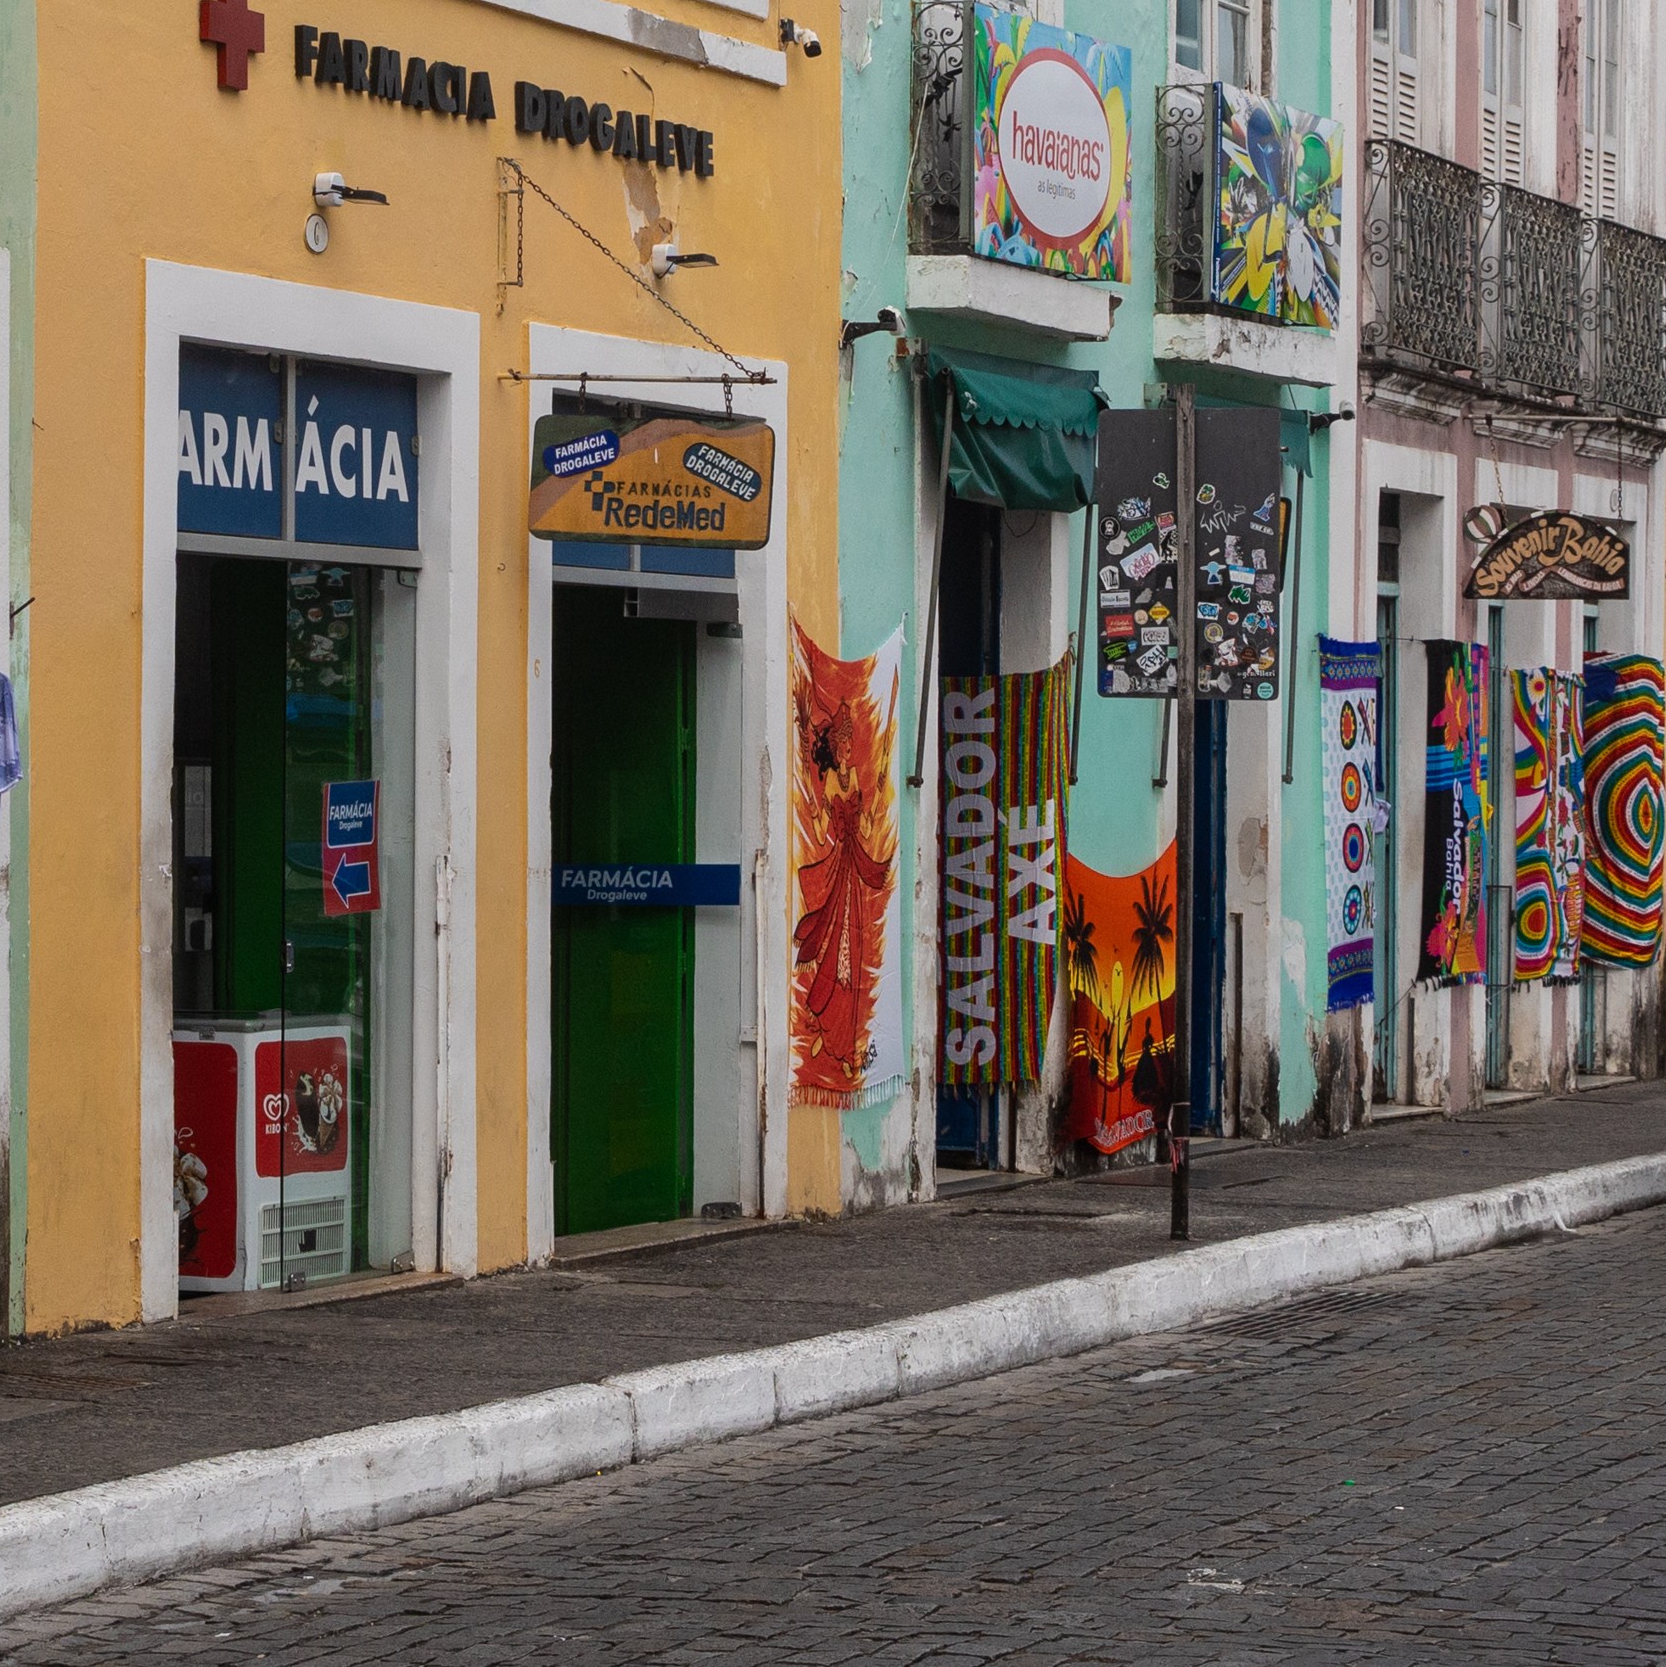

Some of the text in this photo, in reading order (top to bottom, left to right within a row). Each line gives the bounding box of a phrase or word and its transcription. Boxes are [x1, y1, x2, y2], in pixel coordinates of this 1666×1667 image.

[294, 24, 715, 177] FARMACIA DROGALEVE
[1012, 109, 1101, 183] havaianas
[1037, 180, 1046, 194] as
[295, 394, 409, 503] ÁCIA
[553, 447, 615, 476] DROGALEVE
[555, 434, 607, 459] FARMÁCIA
[697, 445, 755, 483] FARMÁCIA
[685, 454, 756, 502] DROGALEVE
[604, 497, 726, 531] RedeMed
[1475, 517, 1625, 597] Souvenir Bahia
[329, 800, 373, 821] FARMÁCIA
[1446, 838, 1454, 891] Bahia
[1452, 777, 1463, 915] Salvador
[561, 866, 673, 889] FARMÁCIA
[944, 686, 997, 1067] SALVADOR
[997, 797, 1057, 946] AXÉ
[587, 889, 647, 902] Drogaleve
[265, 1123, 289, 1135] KIBON
